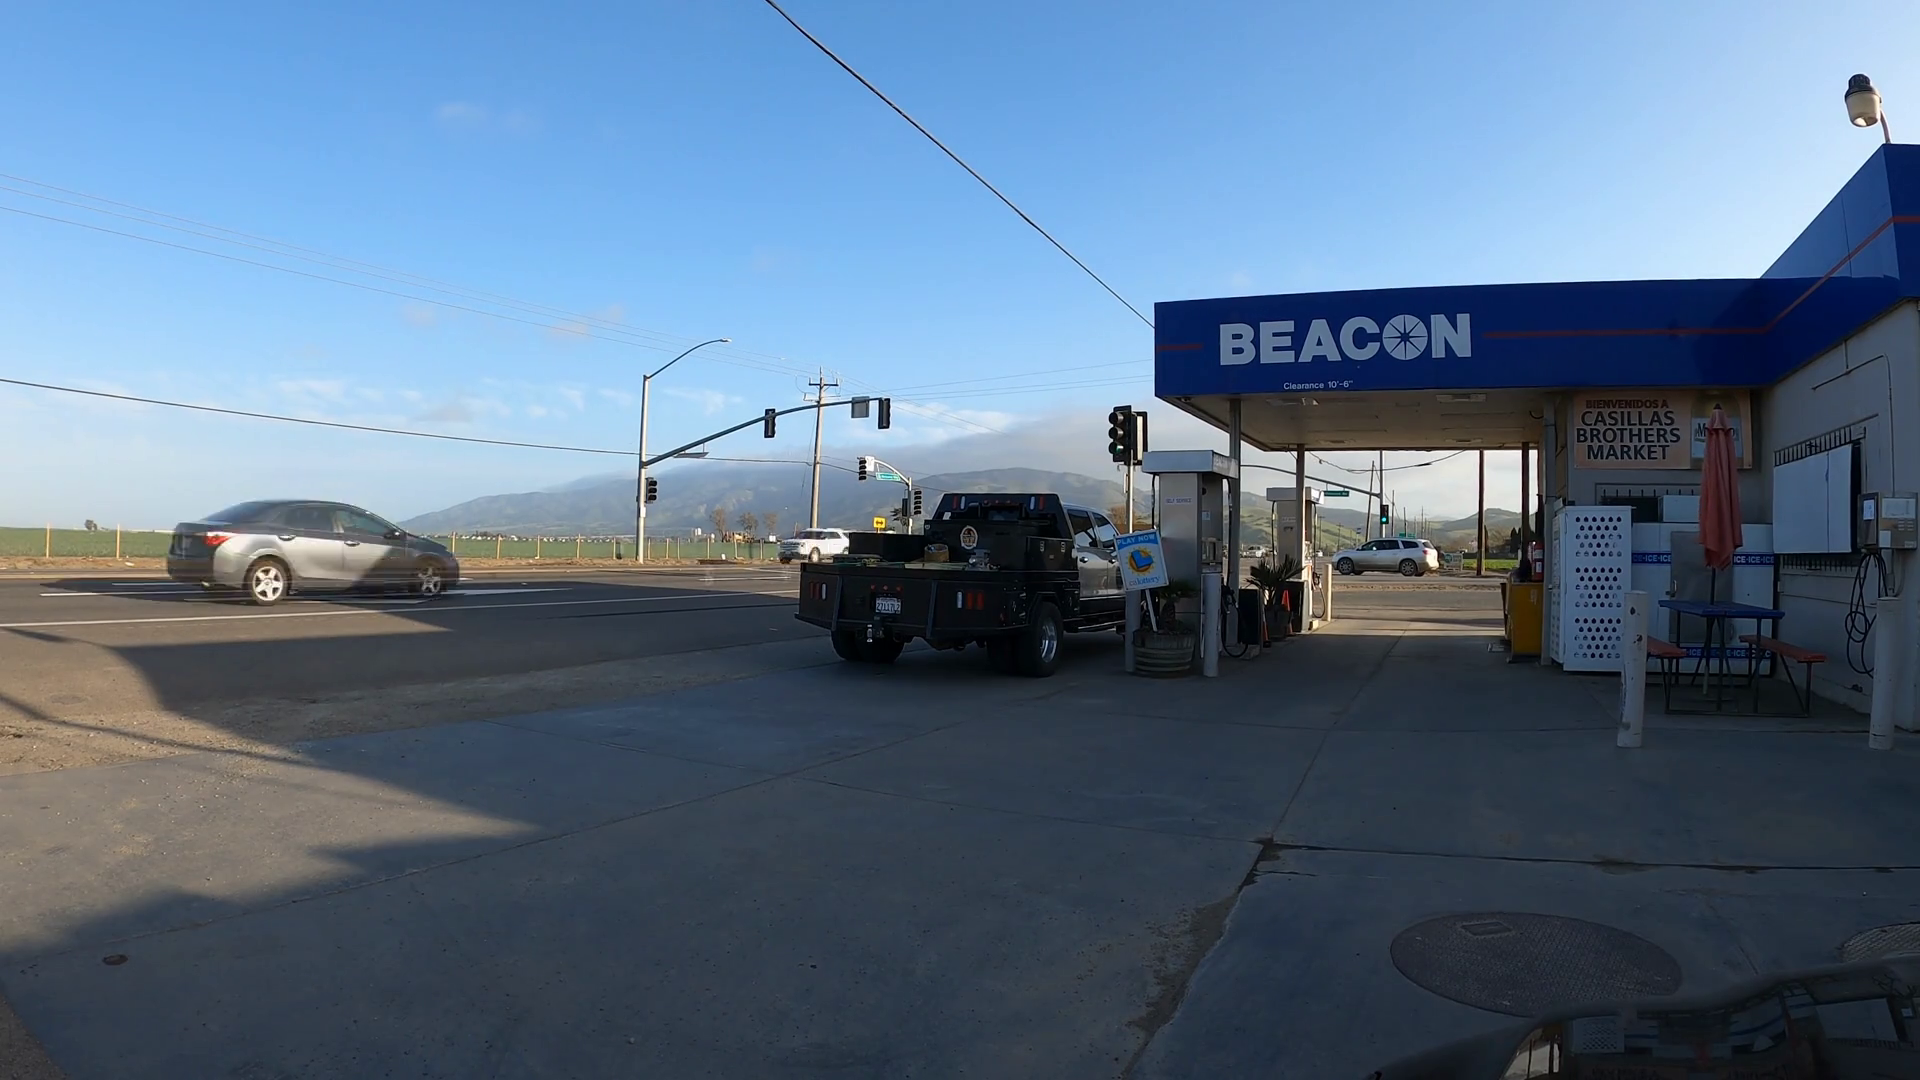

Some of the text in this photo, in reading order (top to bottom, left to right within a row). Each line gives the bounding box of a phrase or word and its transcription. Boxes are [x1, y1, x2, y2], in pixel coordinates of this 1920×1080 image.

[1219, 313, 1472, 366] BEACON
[1283, 382, 1325, 390] Clearance
[1585, 399, 1669, 409] BIENVENIDOS A
[1580, 410, 1676, 427] CASILLAS
[1576, 427, 1681, 444] BROTHERS
[1587, 444, 1670, 460] MARKET
[1138, 534, 1155, 542] NOW
